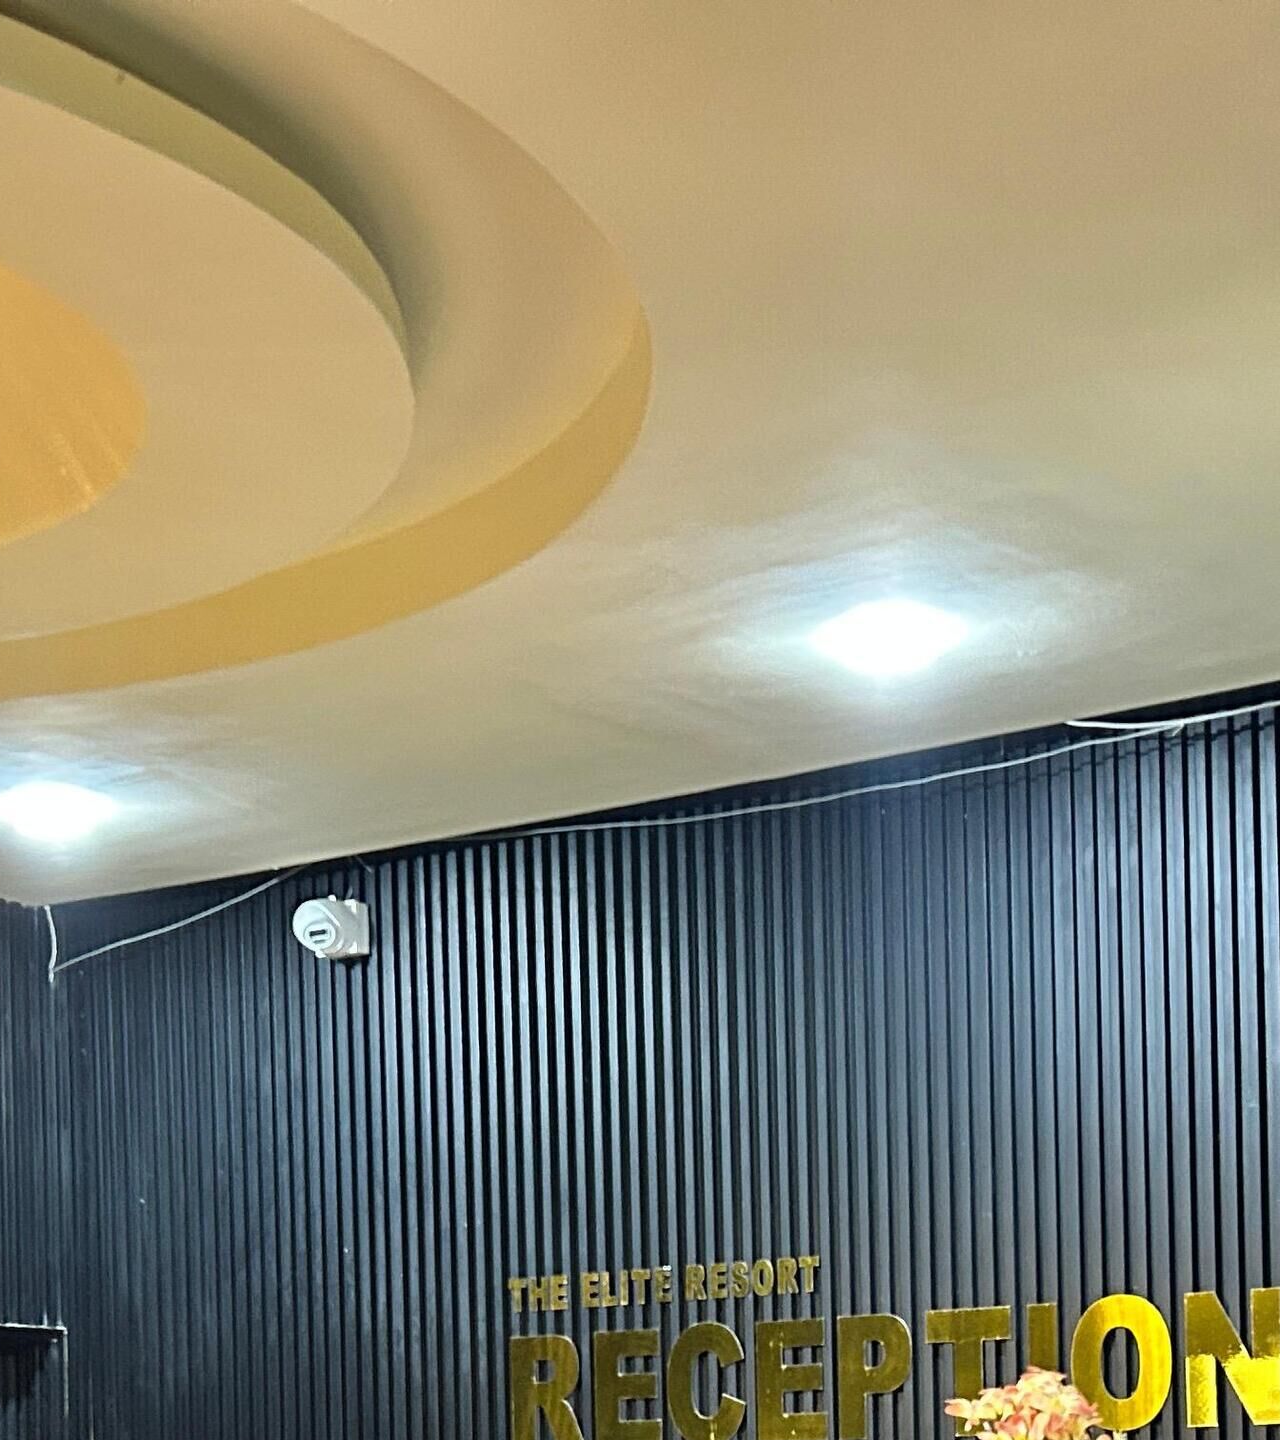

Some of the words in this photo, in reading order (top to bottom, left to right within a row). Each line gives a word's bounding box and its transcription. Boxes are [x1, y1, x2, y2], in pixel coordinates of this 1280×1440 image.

[508, 1274, 568, 1312] THE
[580, 1267, 672, 1308] ELITE
[685, 1255, 819, 1300] RESORT
